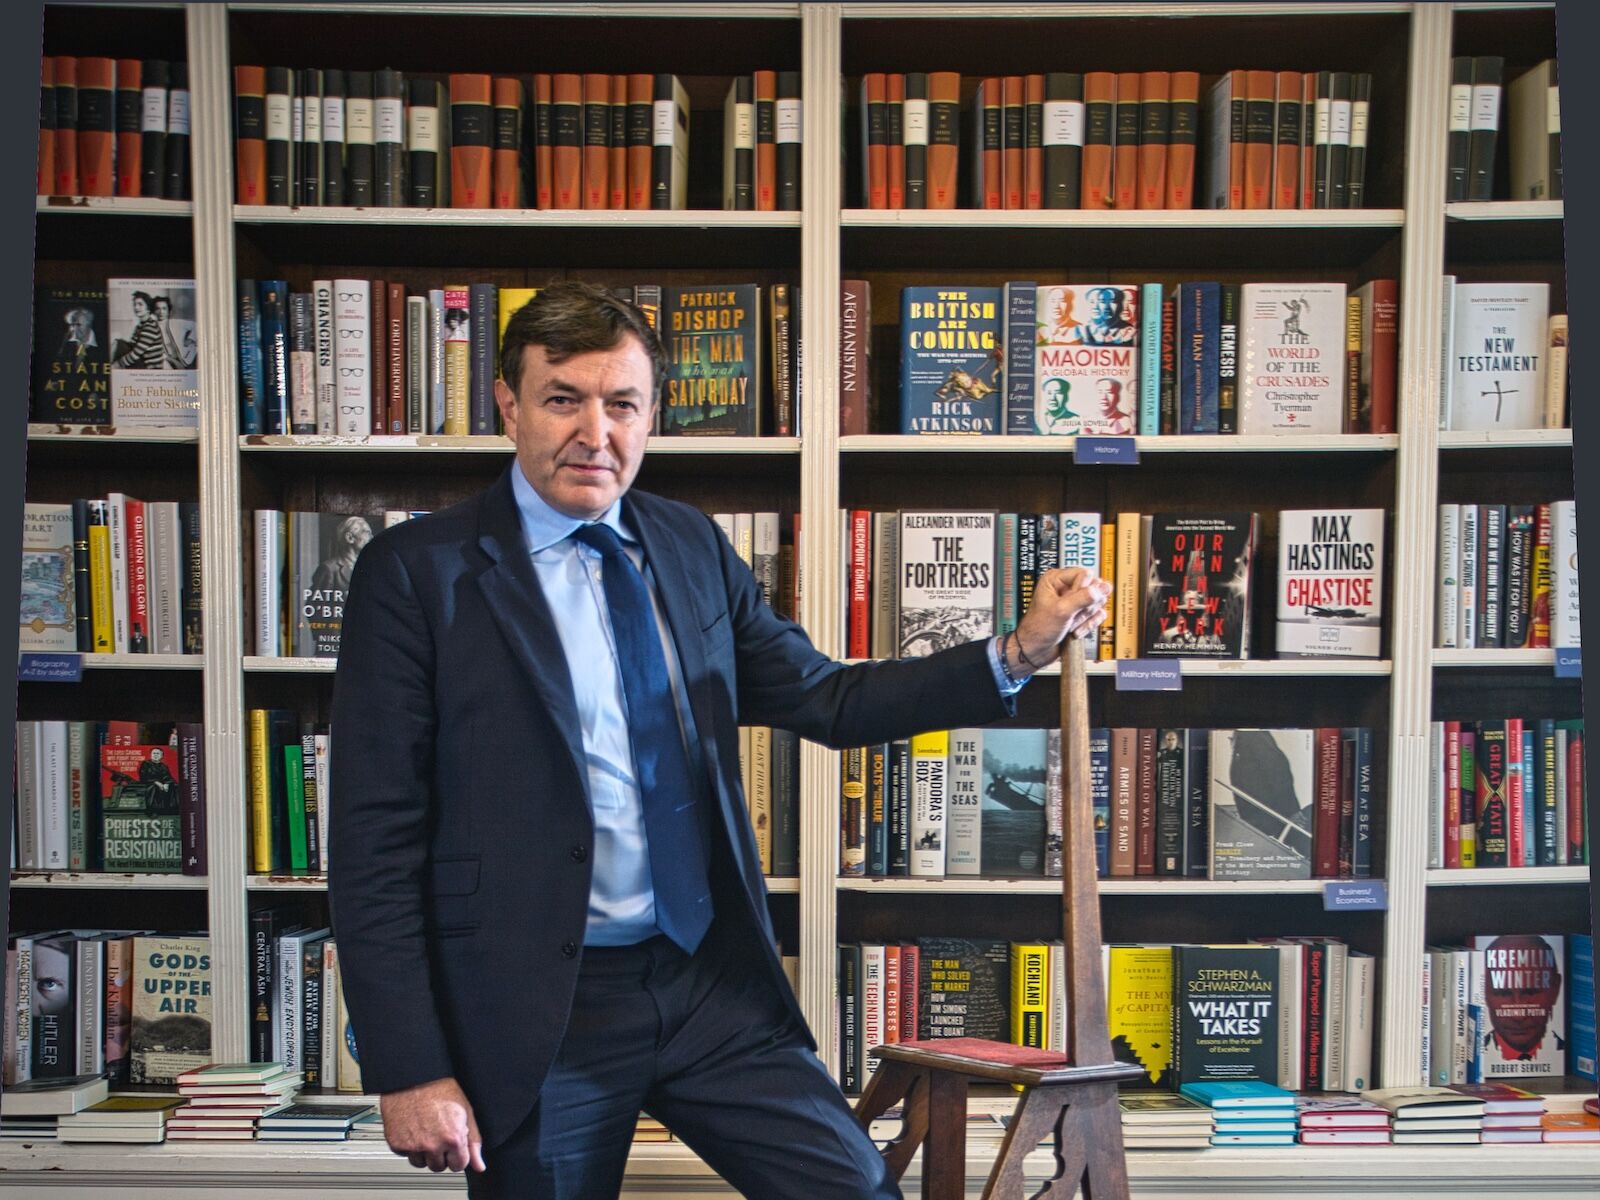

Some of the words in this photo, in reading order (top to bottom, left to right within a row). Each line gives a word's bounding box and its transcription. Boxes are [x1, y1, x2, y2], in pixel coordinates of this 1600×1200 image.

[680, 292, 736, 307] PATRICK
[938, 292, 967, 300] THE
[911, 303, 995, 319] BRITISH
[318, 288, 331, 367] CHANCERS
[672, 309, 744, 330] BISHOP
[1492, 326, 1506, 334] THE
[844, 292, 856, 392] AFGHANISTAN
[910, 331, 994, 350] COMING
[1279, 334, 1310, 345] THE
[1484, 338, 1515, 353] NEW
[76, 345, 87, 356] A
[673, 336, 700, 364] THE
[711, 335, 744, 363] MAN
[1220, 324, 1236, 378] NEMESIS
[1268, 349, 1319, 359] WORLD
[1042, 350, 1130, 367] MAOISM
[1458, 356, 1538, 372] TESTAMENT
[53, 362, 111, 374] STATE
[1266, 362, 1285, 373] OF
[1295, 362, 1320, 373] THE
[45, 380, 65, 391] AT
[1256, 376, 1329, 387] CRUSADES
[121, 386, 142, 396] The
[147, 386, 198, 397] Fabulous
[669, 377, 748, 406] SATURDAY
[1265, 392, 1320, 403] Christopher
[56, 398, 109, 410] COST
[118, 399, 161, 409] Bouvier
[164, 399, 200, 410] Sisters
[932, 402, 971, 415] RICK
[1273, 403, 1312, 413] Tyerman
[909, 418, 993, 431] ATKINSON
[1095, 446, 1119, 454] History
[905, 516, 953, 529] ALEXANDER
[956, 516, 991, 529] WATSON
[1312, 516, 1351, 542] MAX
[135, 516, 144, 564] OBLIVION
[855, 518, 865, 565] CHECKPOINT
[1175, 534, 1224, 551] OUR
[932, 537, 964, 562] THE
[1288, 543, 1374, 570] HASTINGS
[1172, 555, 1222, 572] MAN
[136, 567, 145, 581] OR
[905, 563, 990, 588] FORTRESS
[855, 567, 865, 602] CHARLIE
[1183, 576, 1208, 592] IN
[1287, 578, 1373, 606] CHASTISE
[137, 584, 146, 616] GLORY
[1168, 597, 1220, 614] NEW
[1160, 618, 1224, 635] YORK
[1185, 643, 1226, 651] HEMMING
[31, 660, 70, 668] Biography
[49, 669, 77, 677] subject
[1151, 671, 1177, 679] History
[956, 742, 975, 751] THE
[955, 756, 977, 766] WAR
[1490, 745, 1502, 789] GREAT
[916, 760, 928, 783] BOX
[1360, 765, 1370, 793] WAR
[929, 761, 943, 822] PANDORA'S
[956, 782, 974, 792] THE
[1119, 767, 1129, 806] ARMIES
[952, 795, 978, 805] SEAS
[1360, 798, 1369, 810] AT
[1119, 810, 1129, 821] OF
[1490, 797, 1502, 834] STATE
[105, 818, 161, 838] PRIESTS
[1359, 814, 1369, 841] SEA
[1119, 824, 1129, 851] SAND
[1336, 896, 1377, 904] Economics
[1339, 888, 1372, 896] Business/
[149, 953, 210, 970] GODS
[931, 960, 946, 968] THE
[947, 960, 959, 968] MAN
[1487, 950, 1555, 968] KREMLIN
[931, 972, 944, 980] WHO
[947, 972, 970, 981] SOLVED
[1027, 954, 1040, 1006] KOCHLAND
[1198, 970, 1248, 980] STEPHEN
[1251, 970, 1261, 980] A.
[1491, 970, 1550, 989] WINTER
[144, 979, 211, 996] UPPER
[931, 982, 946, 991] THE
[947, 982, 970, 991] MARKET
[1188, 981, 1272, 991] SCHWARZMAN
[159, 998, 197, 1014] AIR
[1188, 1002, 1251, 1017] WHAT
[1254, 1002, 1271, 1017] IT
[1199, 1019, 1260, 1035] TAKES
[44, 1015, 58, 1066] HITLER
[1491, 1064, 1519, 1073] ROBERT
[1521, 1063, 1551, 1073] SERVICE
